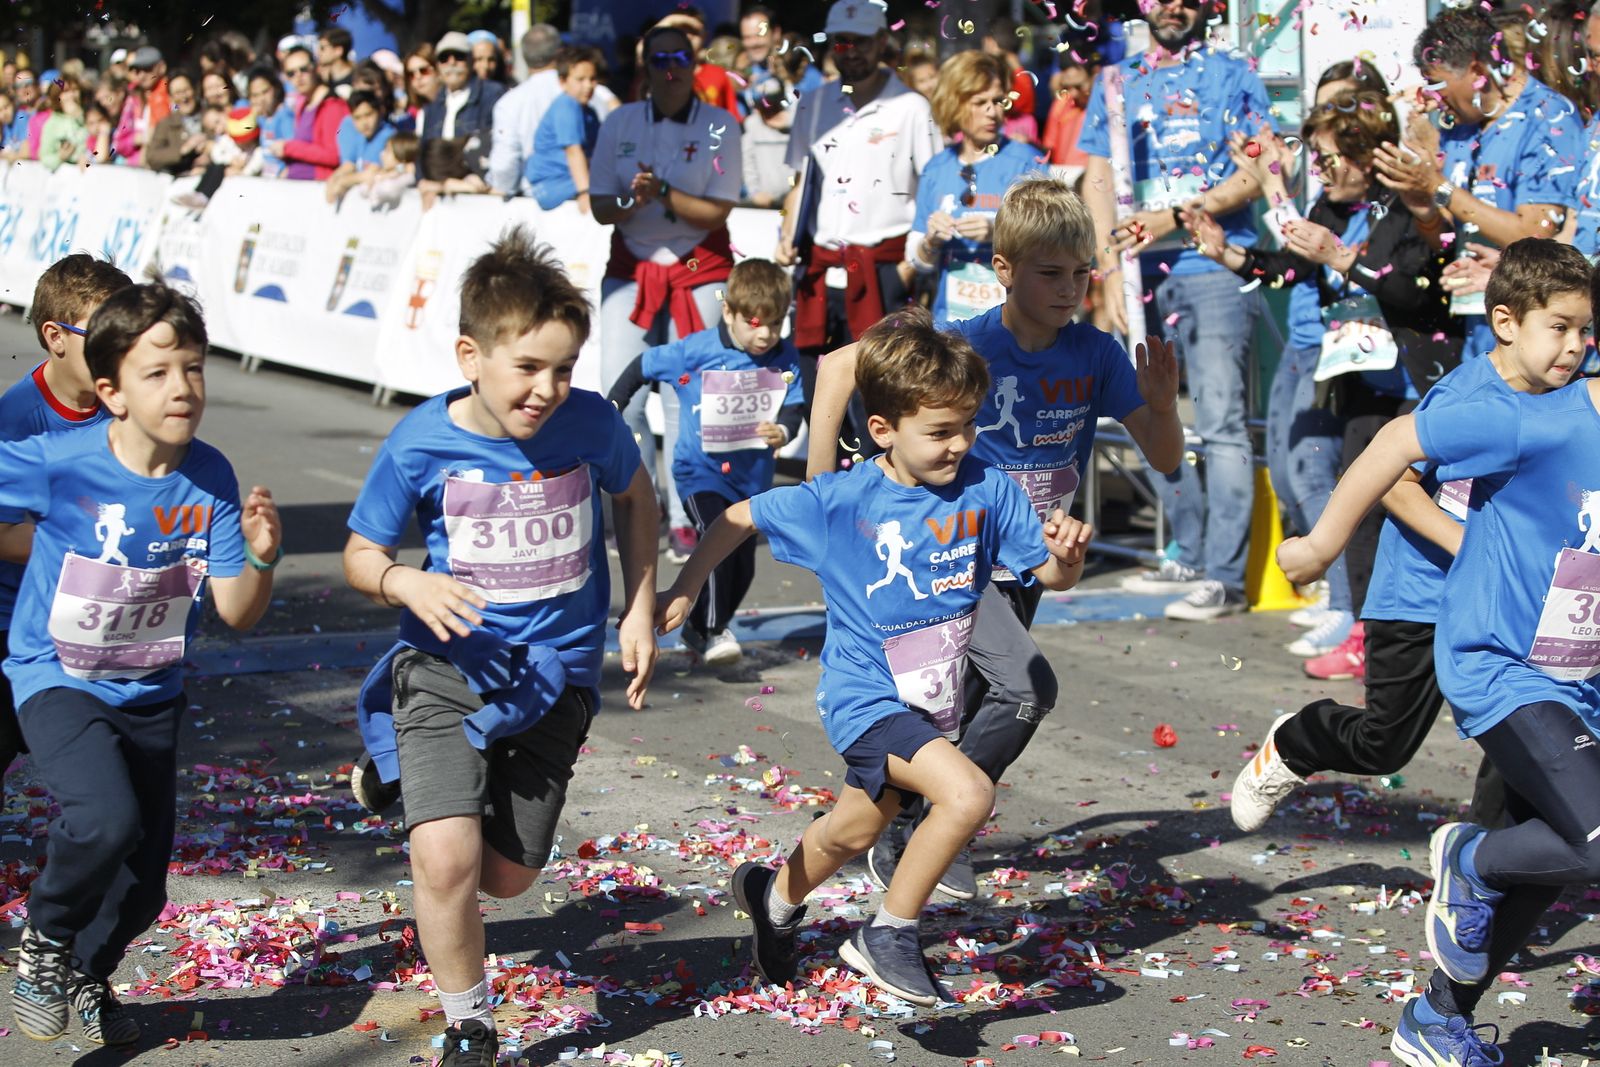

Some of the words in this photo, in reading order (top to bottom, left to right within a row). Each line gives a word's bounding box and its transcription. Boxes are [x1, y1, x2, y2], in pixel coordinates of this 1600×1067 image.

[1039, 376, 1094, 404] VIII
[716, 393, 772, 415] 3239
[1035, 472, 1052, 482] VIII
[519, 484, 544, 494] VIII
[471, 511, 574, 549] 3100
[512, 548, 537, 558] JAVI
[929, 542, 977, 564] CARRE
[78, 602, 170, 631] 3118
[955, 616, 972, 630] VIII
[103, 632, 136, 642] NACHO
[1571, 625, 1592, 636] LEO
